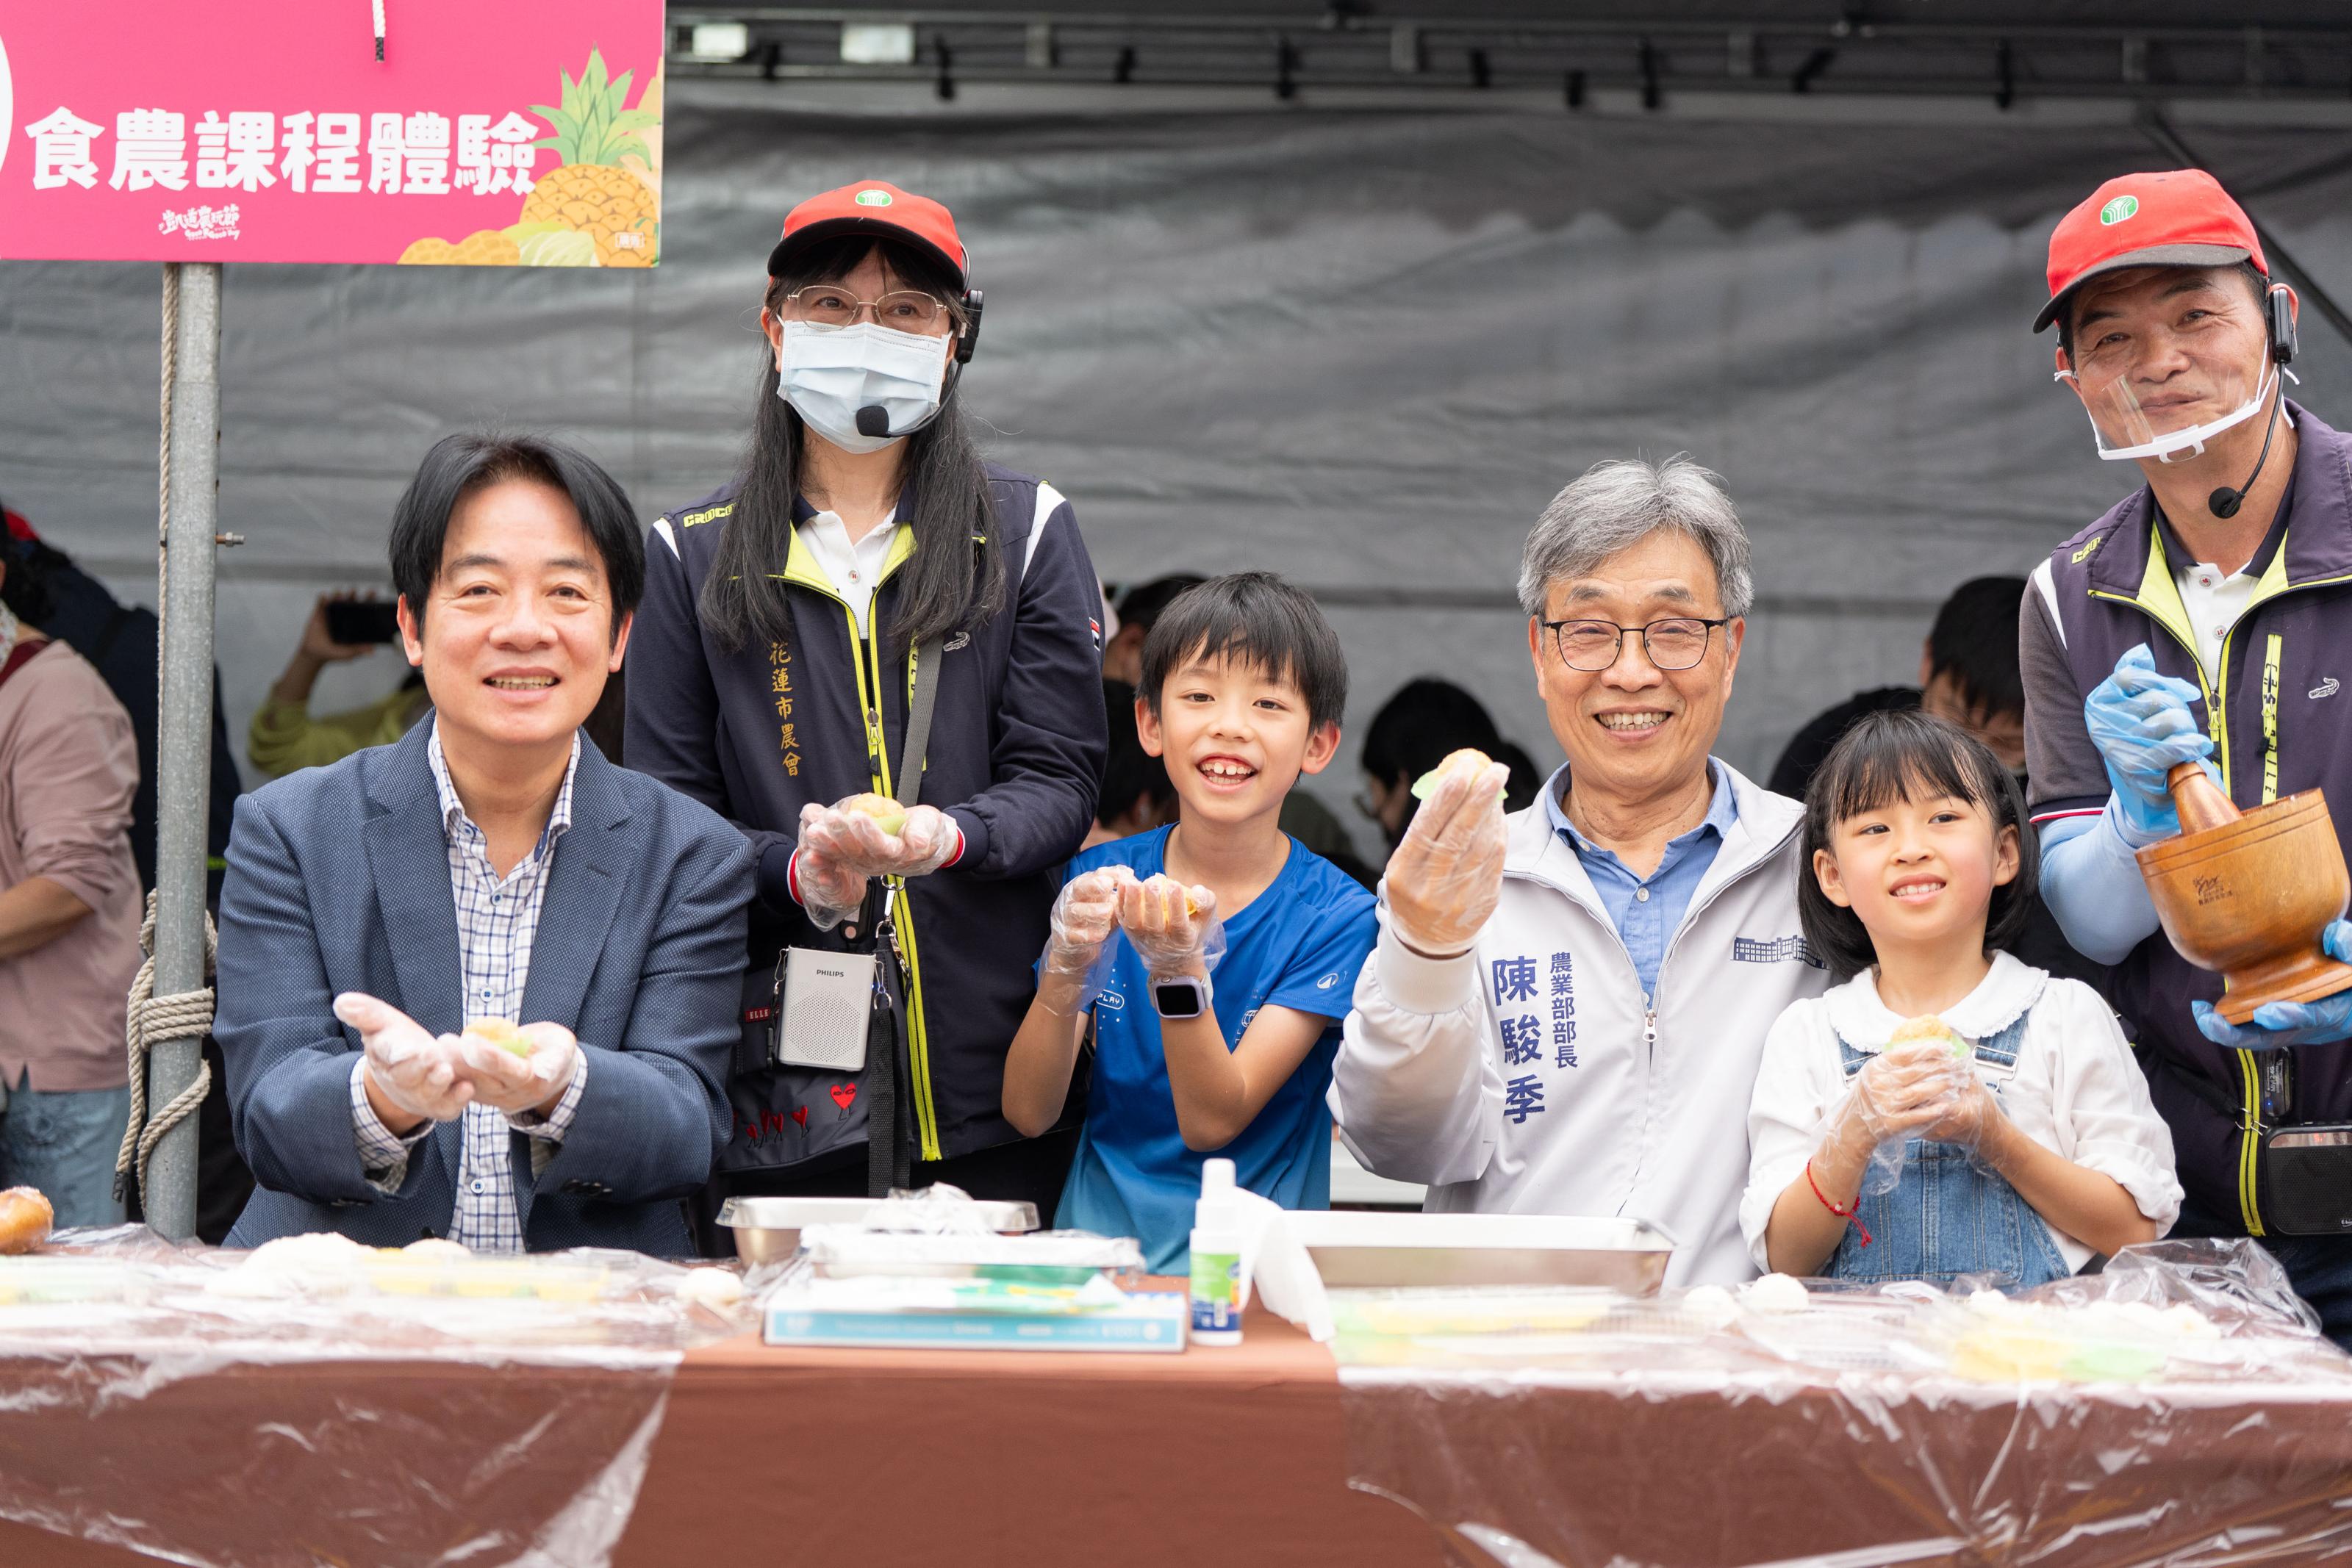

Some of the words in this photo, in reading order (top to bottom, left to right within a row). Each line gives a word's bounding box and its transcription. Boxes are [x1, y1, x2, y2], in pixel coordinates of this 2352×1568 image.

[25, 106, 539, 195] 食農課程體驗
[769, 641, 801, 776] 花蓮市農會
[750, 1009, 769, 1019] ELLE
[817, 969, 845, 977] PHILIPS
[1097, 993, 1120, 1004] PLAY
[1549, 952, 1578, 1069] 農業部部長
[1492, 954, 1546, 1124] 陳駿季
